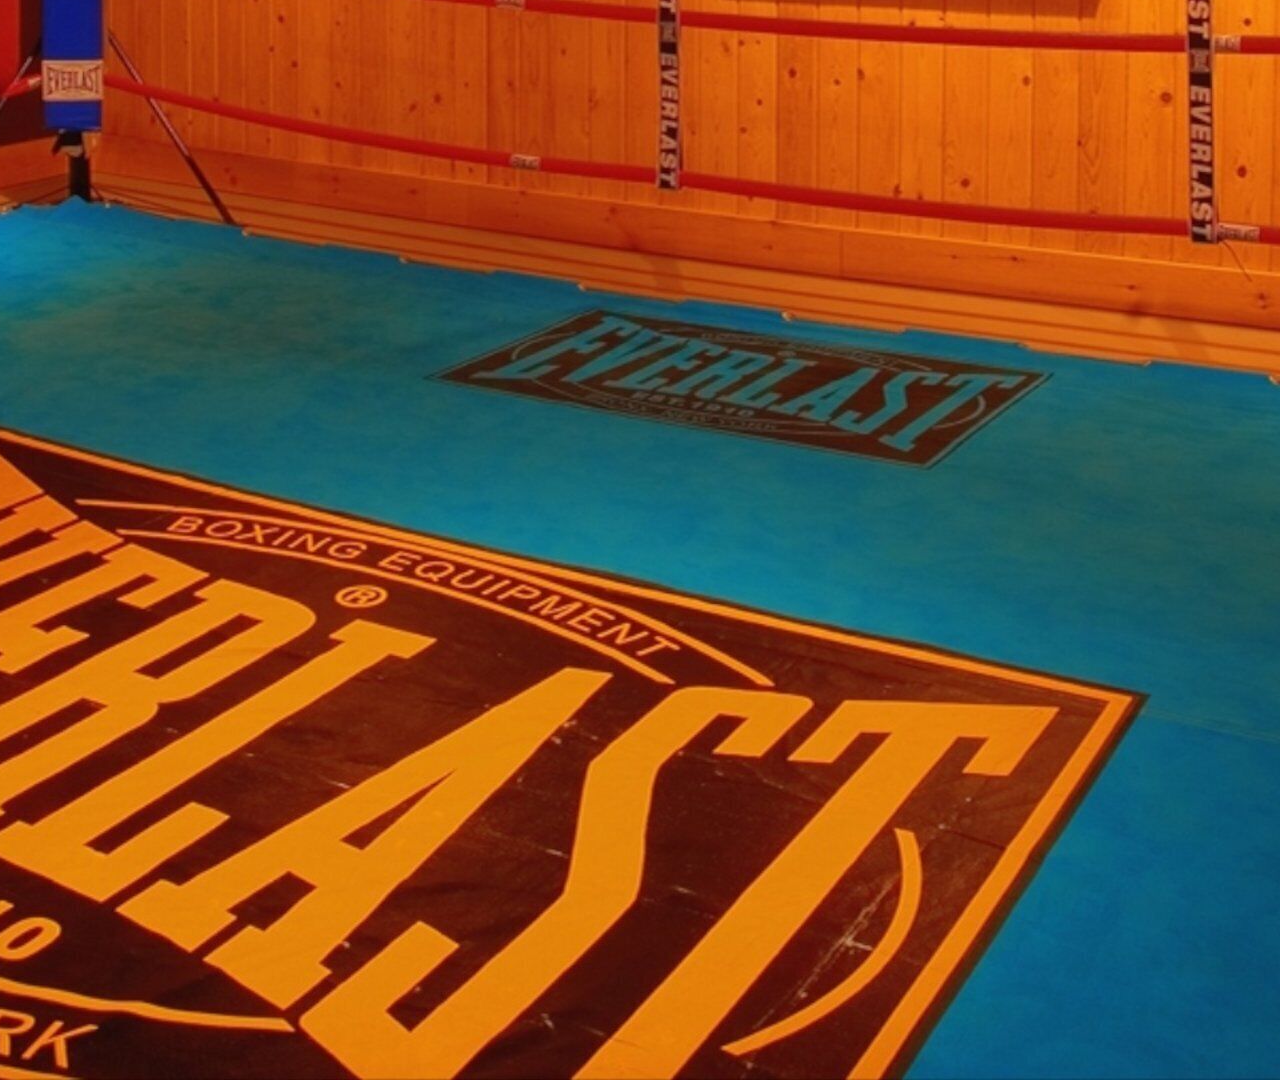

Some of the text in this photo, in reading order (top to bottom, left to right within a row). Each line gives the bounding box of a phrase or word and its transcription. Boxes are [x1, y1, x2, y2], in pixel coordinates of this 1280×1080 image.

[46, 66, 102, 95] EVERLAST
[658, 53, 679, 186] EVERLAST
[1190, 85, 1214, 242] EVERLAST
[474, 317, 1020, 453] EVERLAST
[166, 513, 683, 659] BOXING EQUIPMENT
